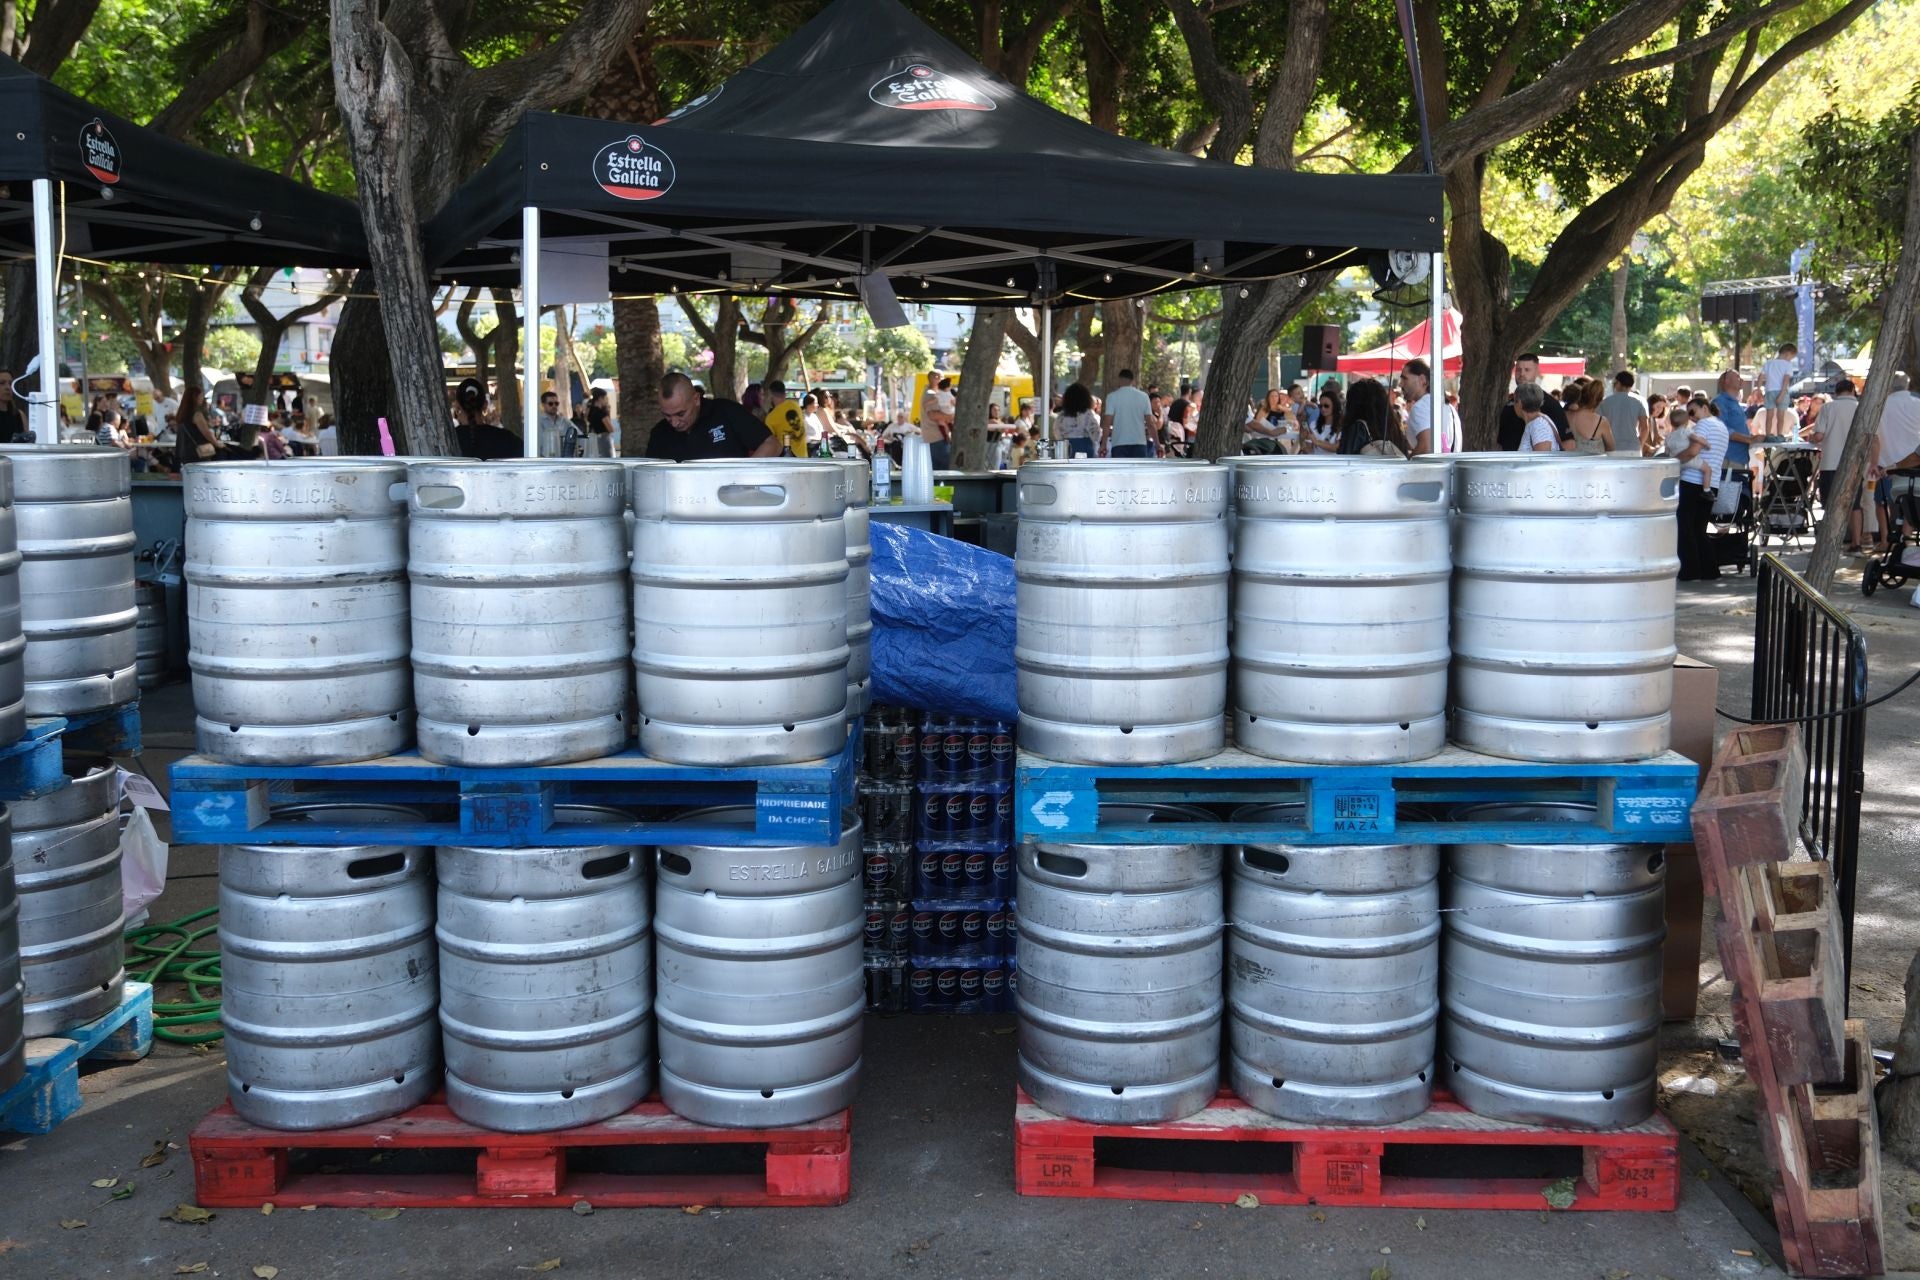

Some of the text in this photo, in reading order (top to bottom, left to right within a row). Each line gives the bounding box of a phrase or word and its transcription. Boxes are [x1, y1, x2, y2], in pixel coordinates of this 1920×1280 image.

[86, 133, 115, 157] Estrella
[89, 149, 114, 171] Galicia
[607, 151, 662, 172] Estrella
[608, 167, 659, 187] Galicia
[193, 486, 337, 504] ESTRELLA GALICIA
[525, 483, 600, 502] ESTRELLA
[1096, 487, 1178, 505] ESTRELLA
[1278, 486, 1337, 503] GALICIA
[1466, 482, 1611, 499] ESTRELLA GALICIA
[756, 799, 828, 809] PROPRIEDADE
[768, 815, 815, 824] DA CHEP
[1334, 821, 1378, 831] MAZA
[729, 850, 855, 881] ESTRELLA GALICIA
[1043, 1164, 1072, 1178] LPR
[1617, 1168, 1656, 1181] SAZ-24
[1625, 1186, 1648, 1199] 49-3
